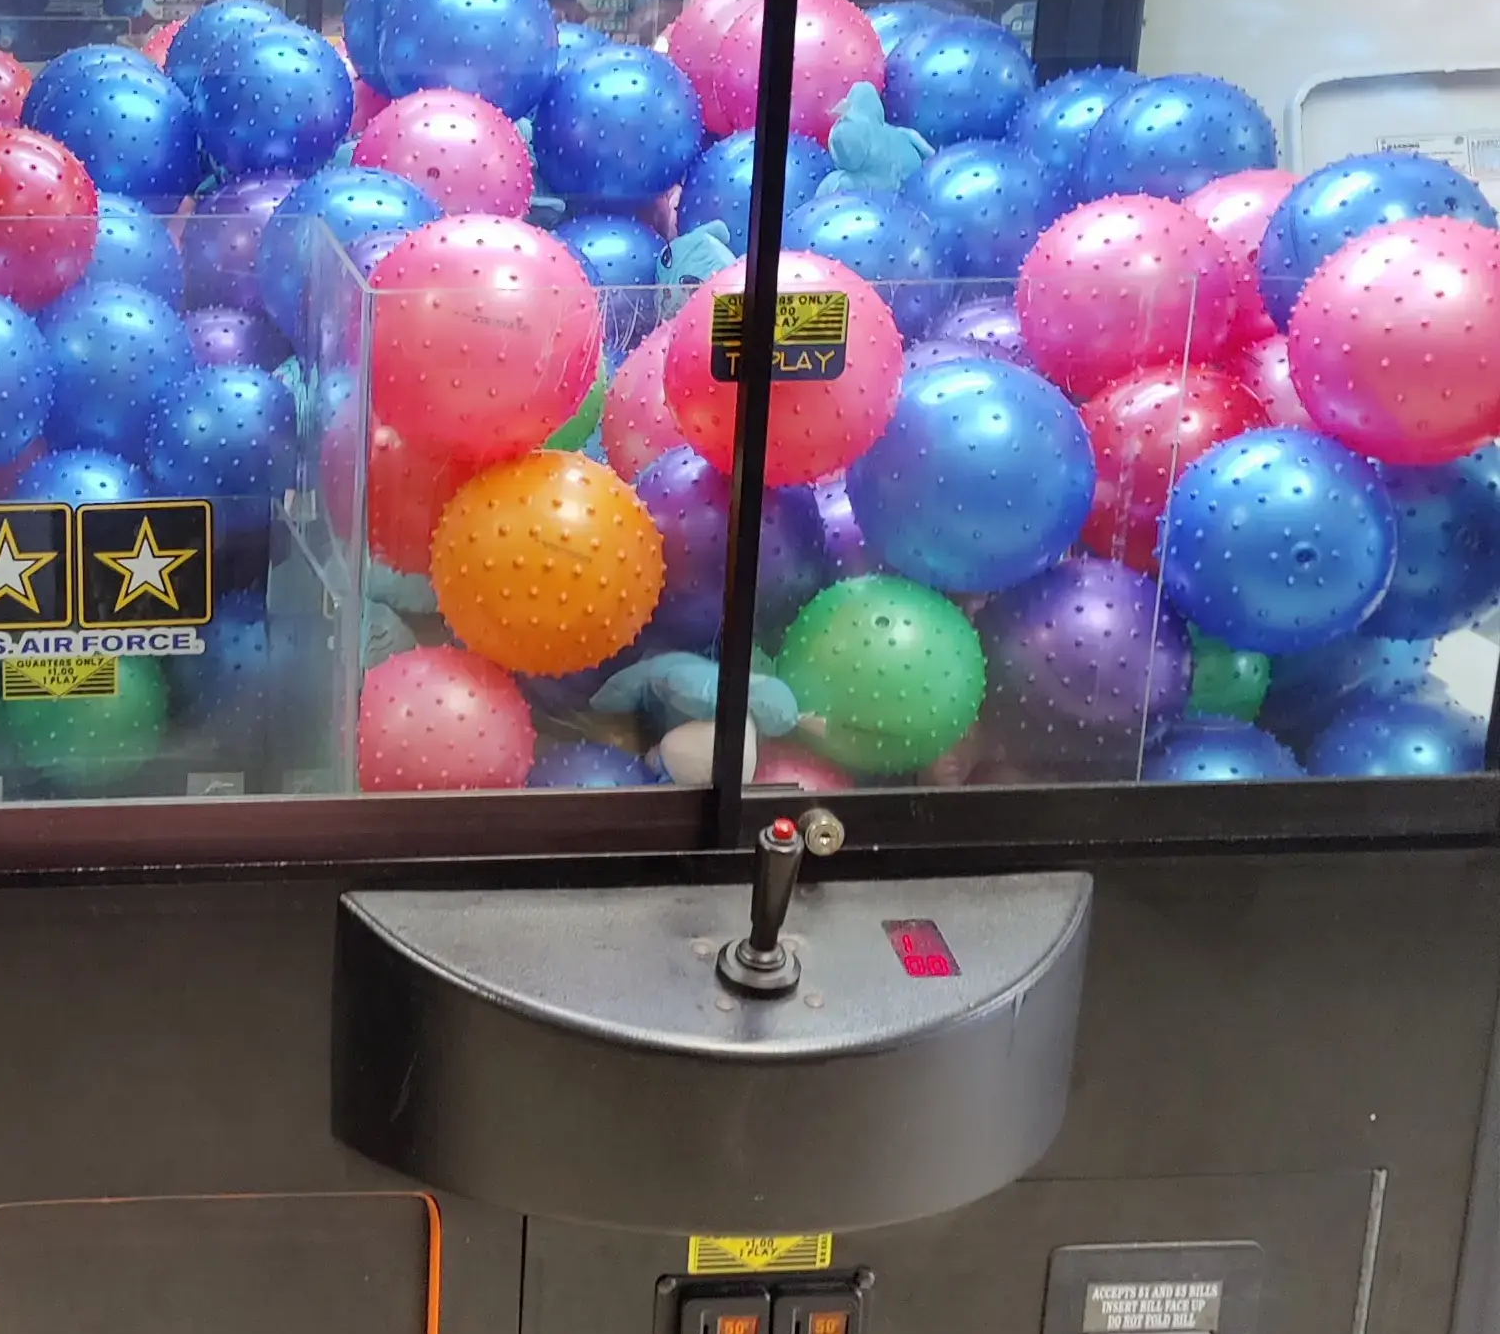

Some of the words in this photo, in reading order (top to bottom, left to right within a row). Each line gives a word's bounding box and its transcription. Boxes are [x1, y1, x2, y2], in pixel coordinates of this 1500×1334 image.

[799, 294, 833, 305] ONLY
[20, 636, 74, 655] AIR
[16, 659, 72, 668] QUARTERS
[75, 657, 105, 667] ONLY
[50, 675, 79, 684] PLAY
[747, 1247, 778, 1257] PLAY
[1092, 1285, 1136, 1301] ACCEPTS
[1151, 1285, 1174, 1299] AND
[1188, 1283, 1218, 1298] BILLS
[1101, 1300, 1138, 1315] INSERT
[1139, 1299, 1163, 1313] BILL
[1164, 1298, 1191, 1313] FACE
[1190, 1298, 1206, 1313] UP
[1106, 1314, 1121, 1331] DO
[1121, 1313, 1144, 1330] NOT
[1144, 1313, 1171, 1330] FOLD
[1171, 1312, 1196, 1329] BILL
